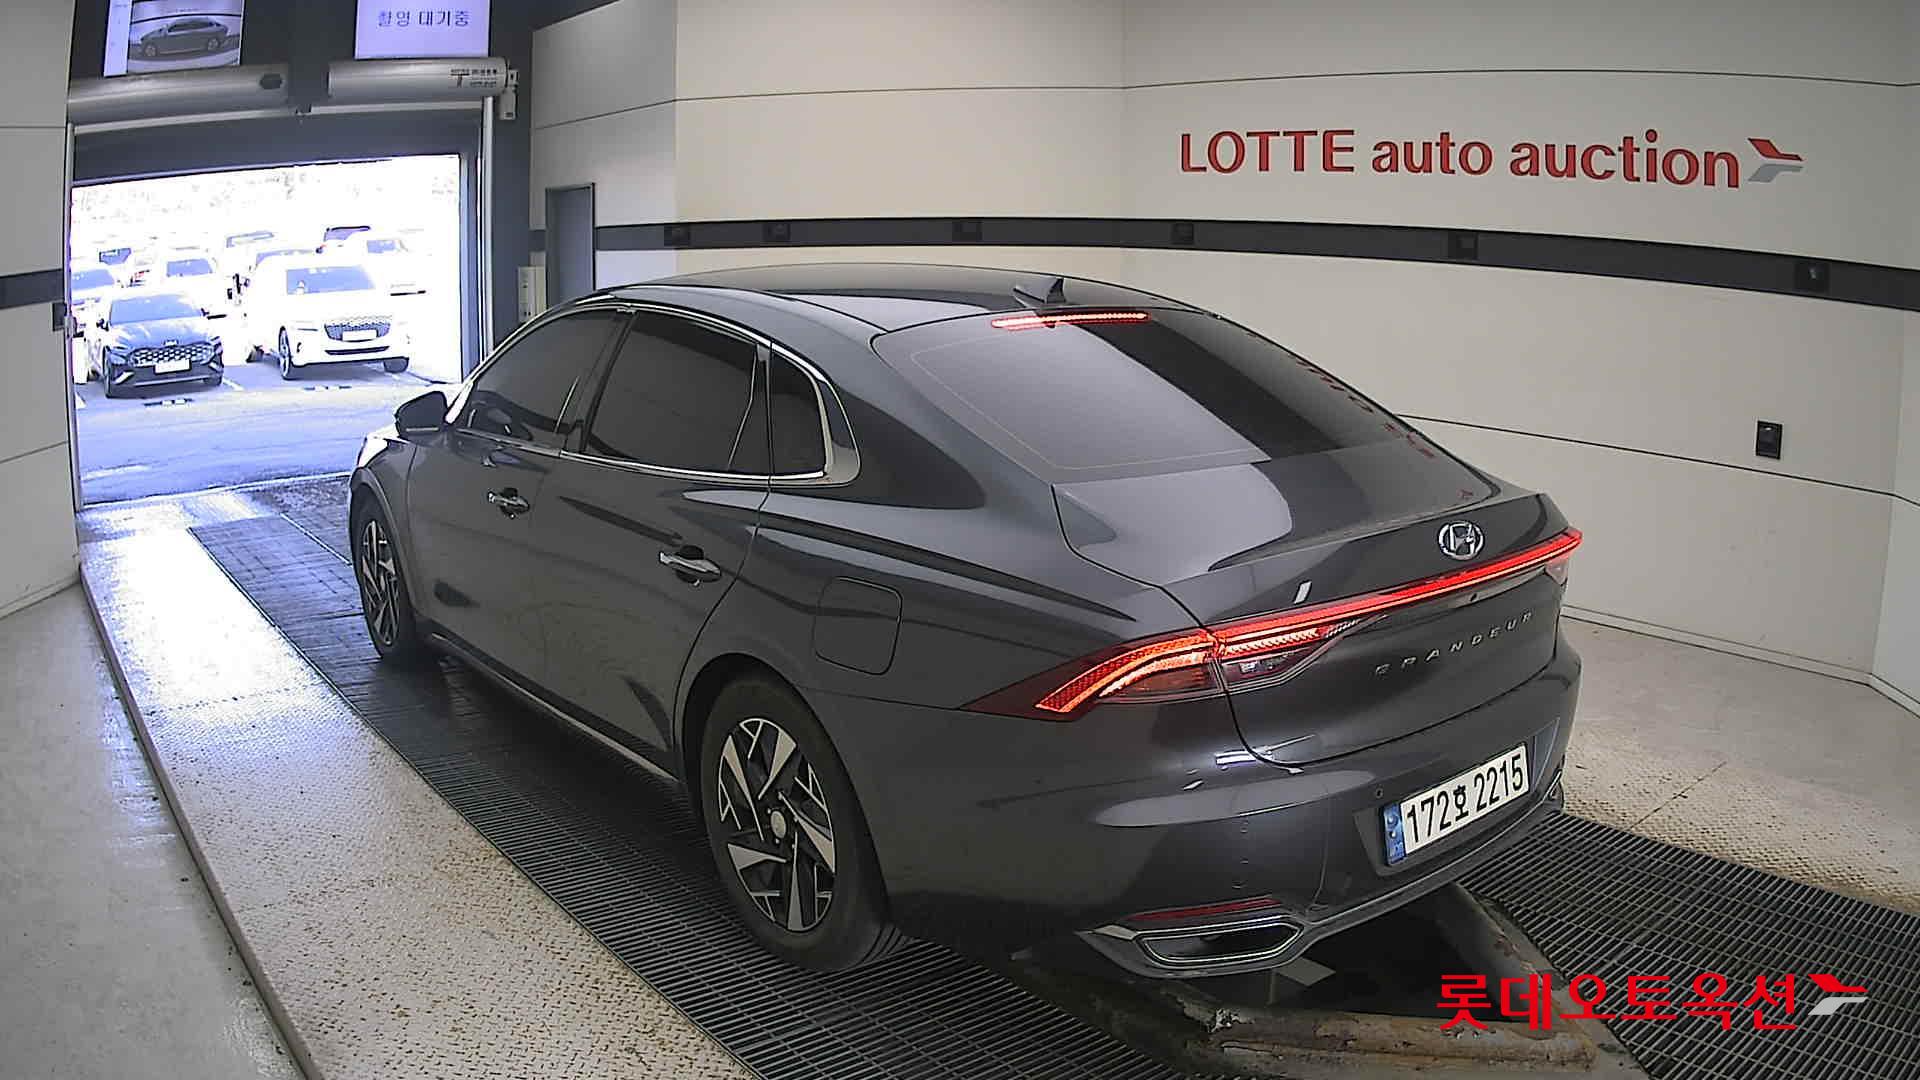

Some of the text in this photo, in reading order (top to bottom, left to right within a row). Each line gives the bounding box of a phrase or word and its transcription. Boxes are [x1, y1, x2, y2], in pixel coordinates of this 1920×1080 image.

[419, 11, 468, 27] 대기중
[1181, 129, 1740, 188] LOTTE auto auction
[1374, 611, 1533, 676] GRANDEUR
[1406, 753, 1524, 844] 172호 2215
